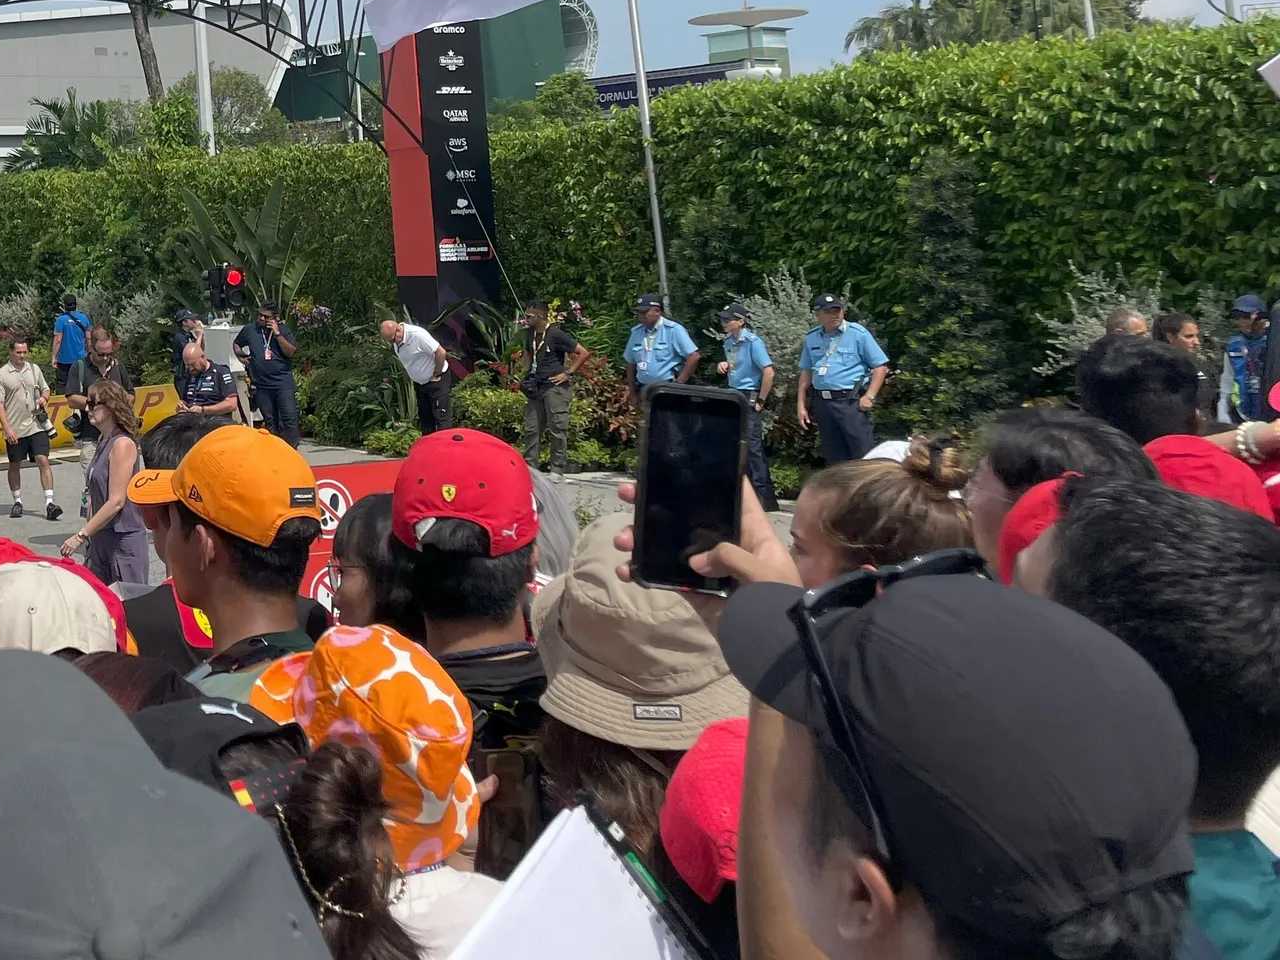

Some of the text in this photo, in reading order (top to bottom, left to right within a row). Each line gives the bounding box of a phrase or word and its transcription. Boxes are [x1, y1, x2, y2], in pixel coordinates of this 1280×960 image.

[433, 26, 465, 34] aramco
[443, 109, 468, 118] QATAR
[448, 137, 467, 146] aws
[456, 169, 476, 178] MSC
